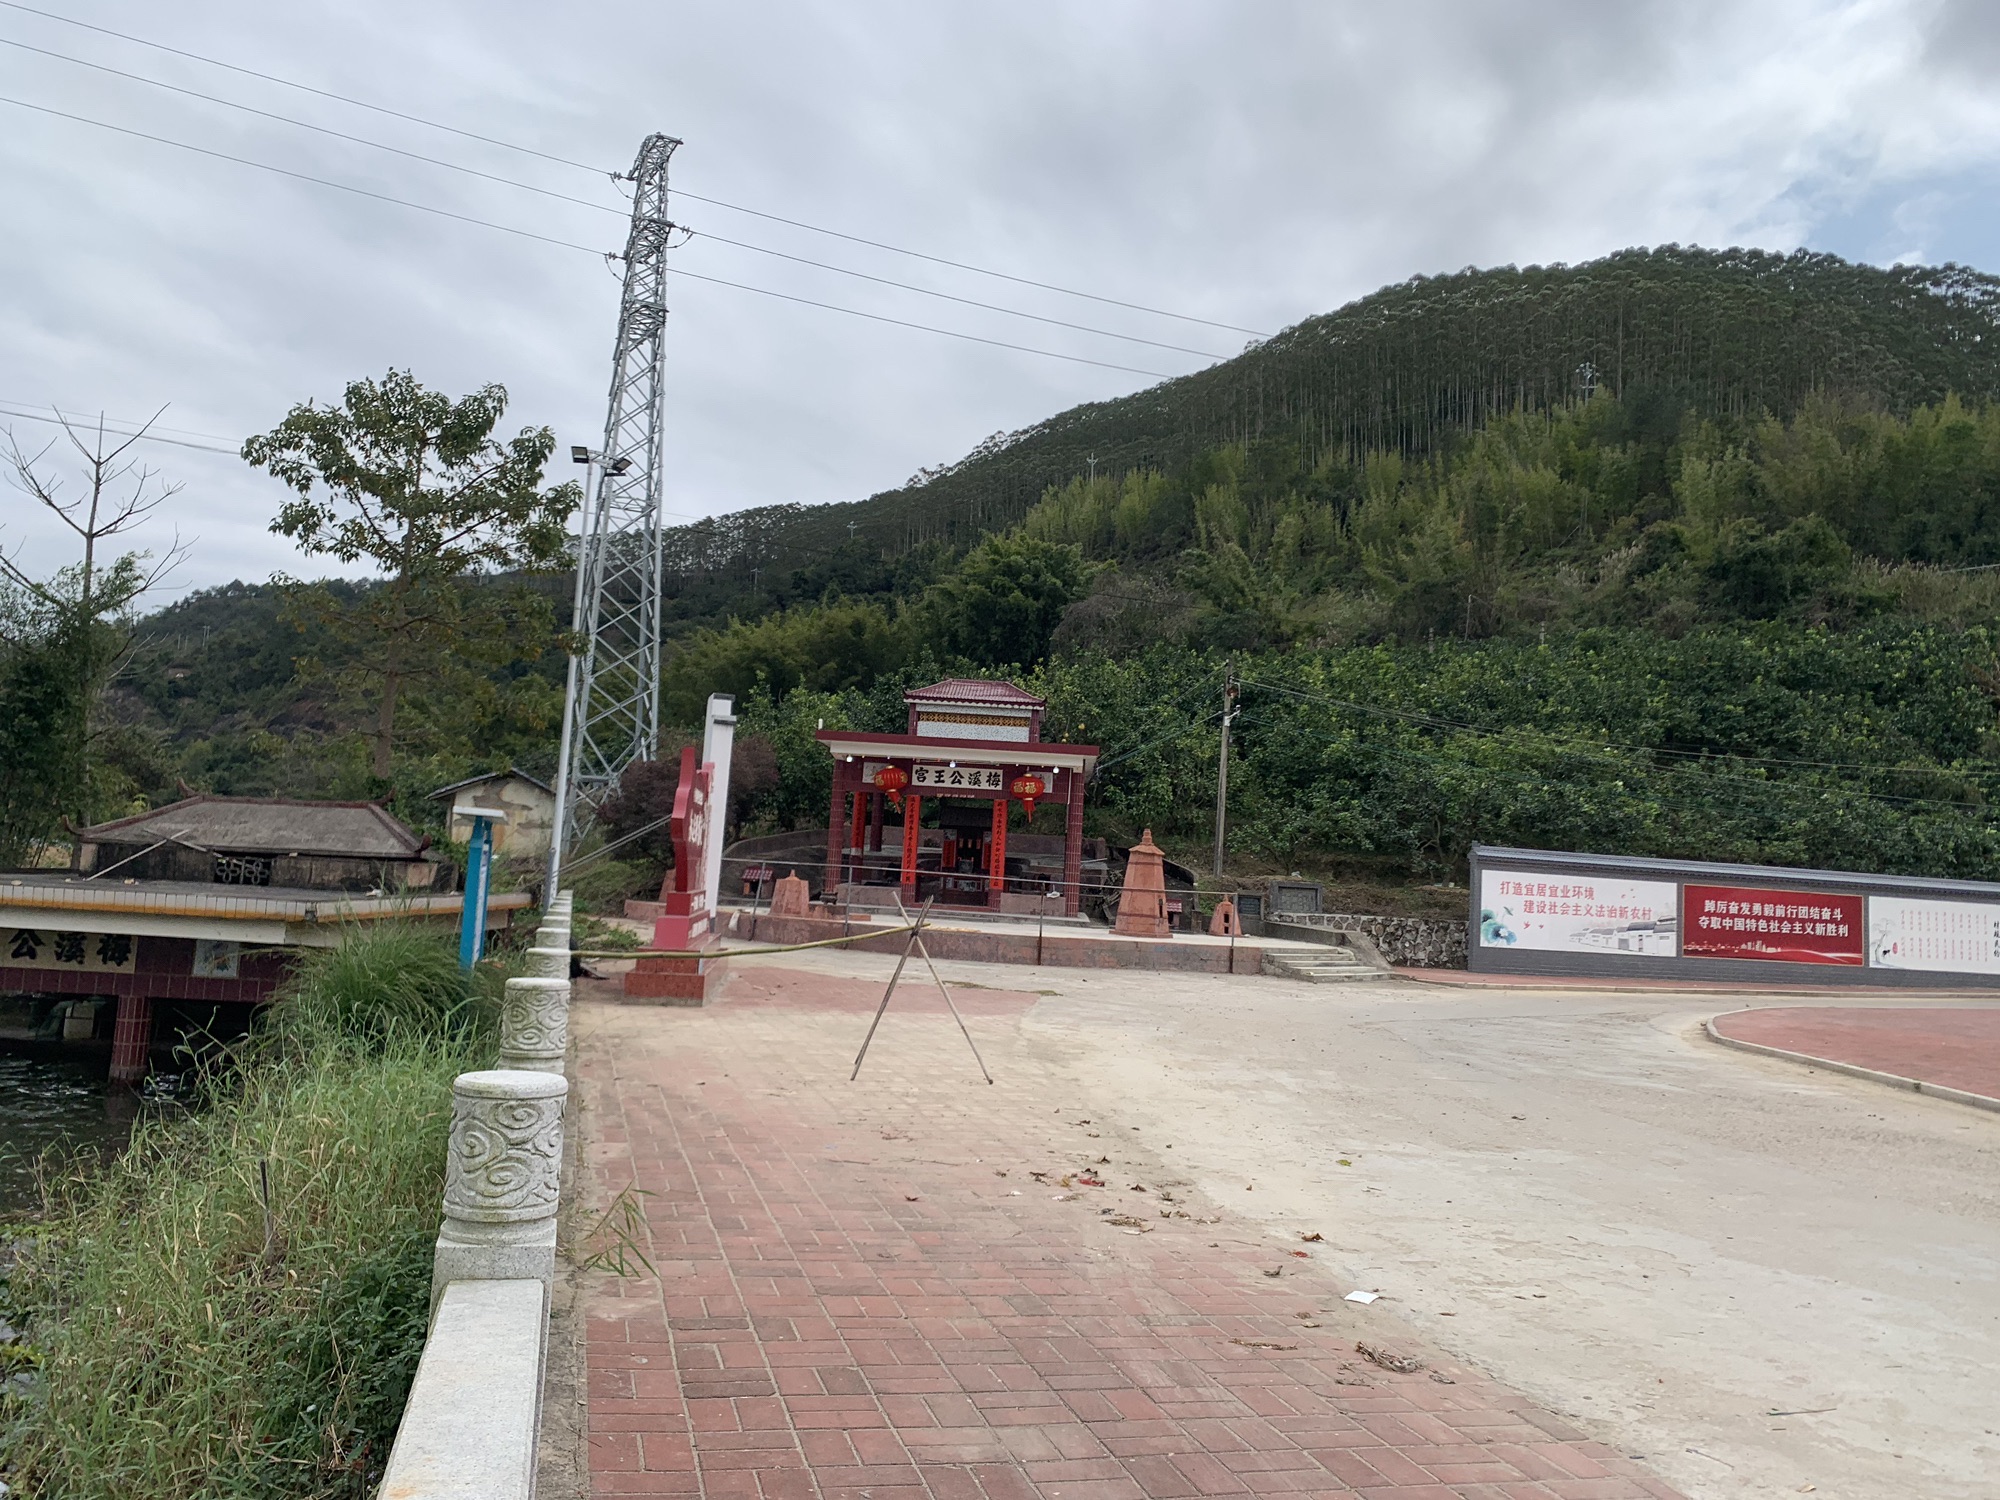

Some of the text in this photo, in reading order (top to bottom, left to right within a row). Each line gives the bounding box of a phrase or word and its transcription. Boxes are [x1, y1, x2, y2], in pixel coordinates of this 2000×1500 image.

[1500, 881, 1595, 900] 打造宜居宜业环境
[1523, 900, 1652, 920] 建设社会主义法治新农村
[1704, 899, 1843, 921] 踔厉奋发勇毅前行团结奋斗
[1698, 916, 1849, 937] 夺取中国特色社会主义新胜利
